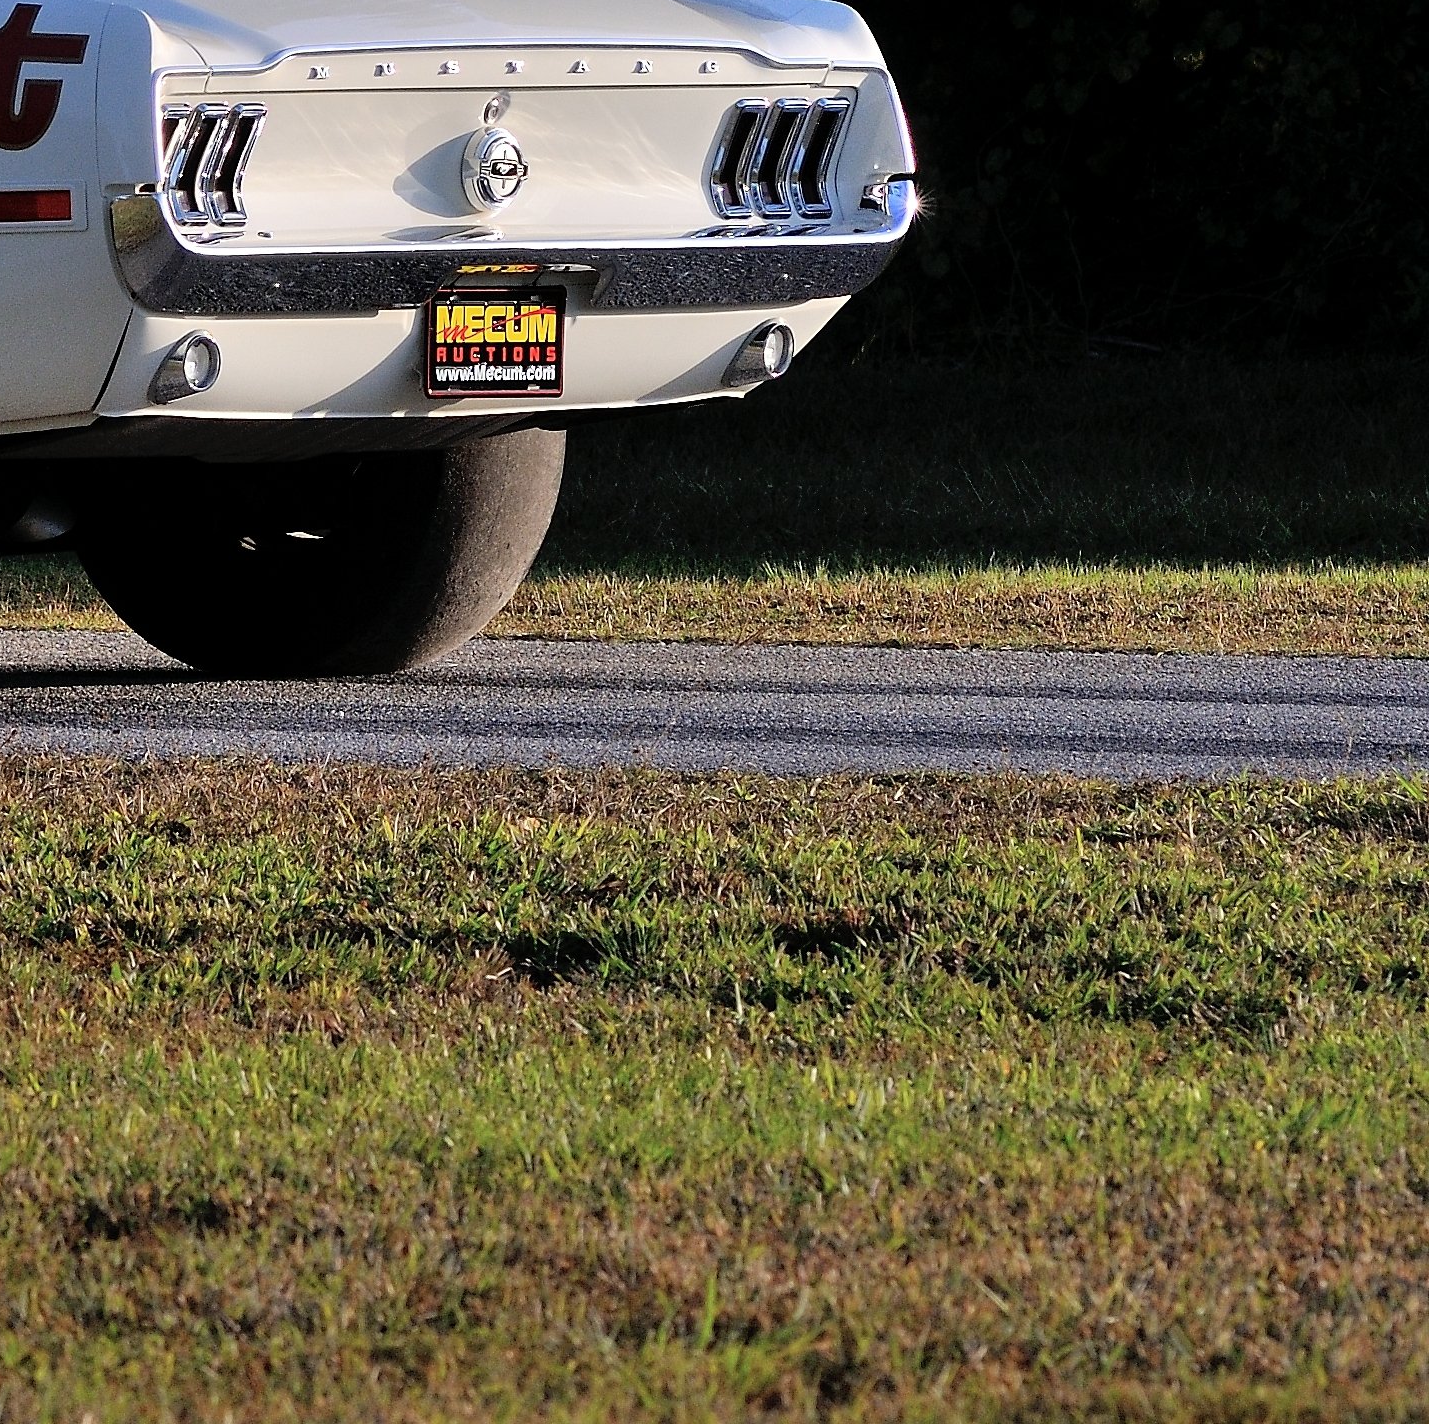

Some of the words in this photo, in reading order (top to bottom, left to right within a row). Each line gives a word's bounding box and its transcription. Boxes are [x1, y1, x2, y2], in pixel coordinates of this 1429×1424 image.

[309, 59, 720, 80] MUSTANG
[435, 305, 557, 343] MECUM
[436, 346, 556, 362] AUCTIONS
[435, 364, 556, 382] www.Mecum.com
